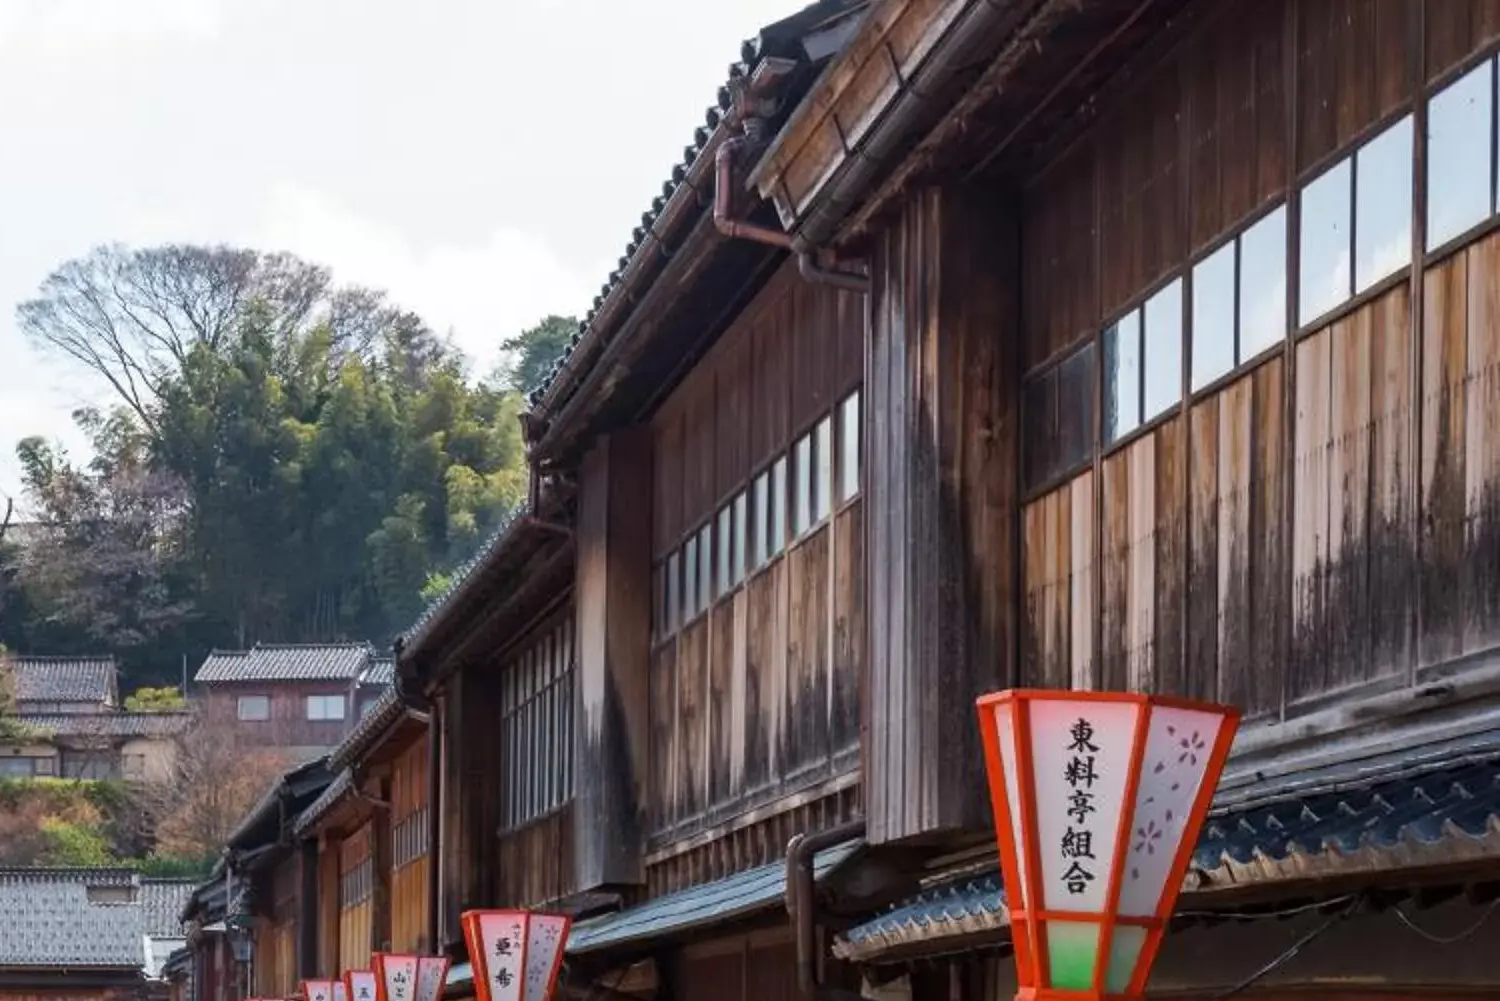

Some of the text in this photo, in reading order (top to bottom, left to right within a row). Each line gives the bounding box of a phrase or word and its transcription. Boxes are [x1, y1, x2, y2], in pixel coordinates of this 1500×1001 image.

[1061, 717, 1099, 895] 東料亭組合
